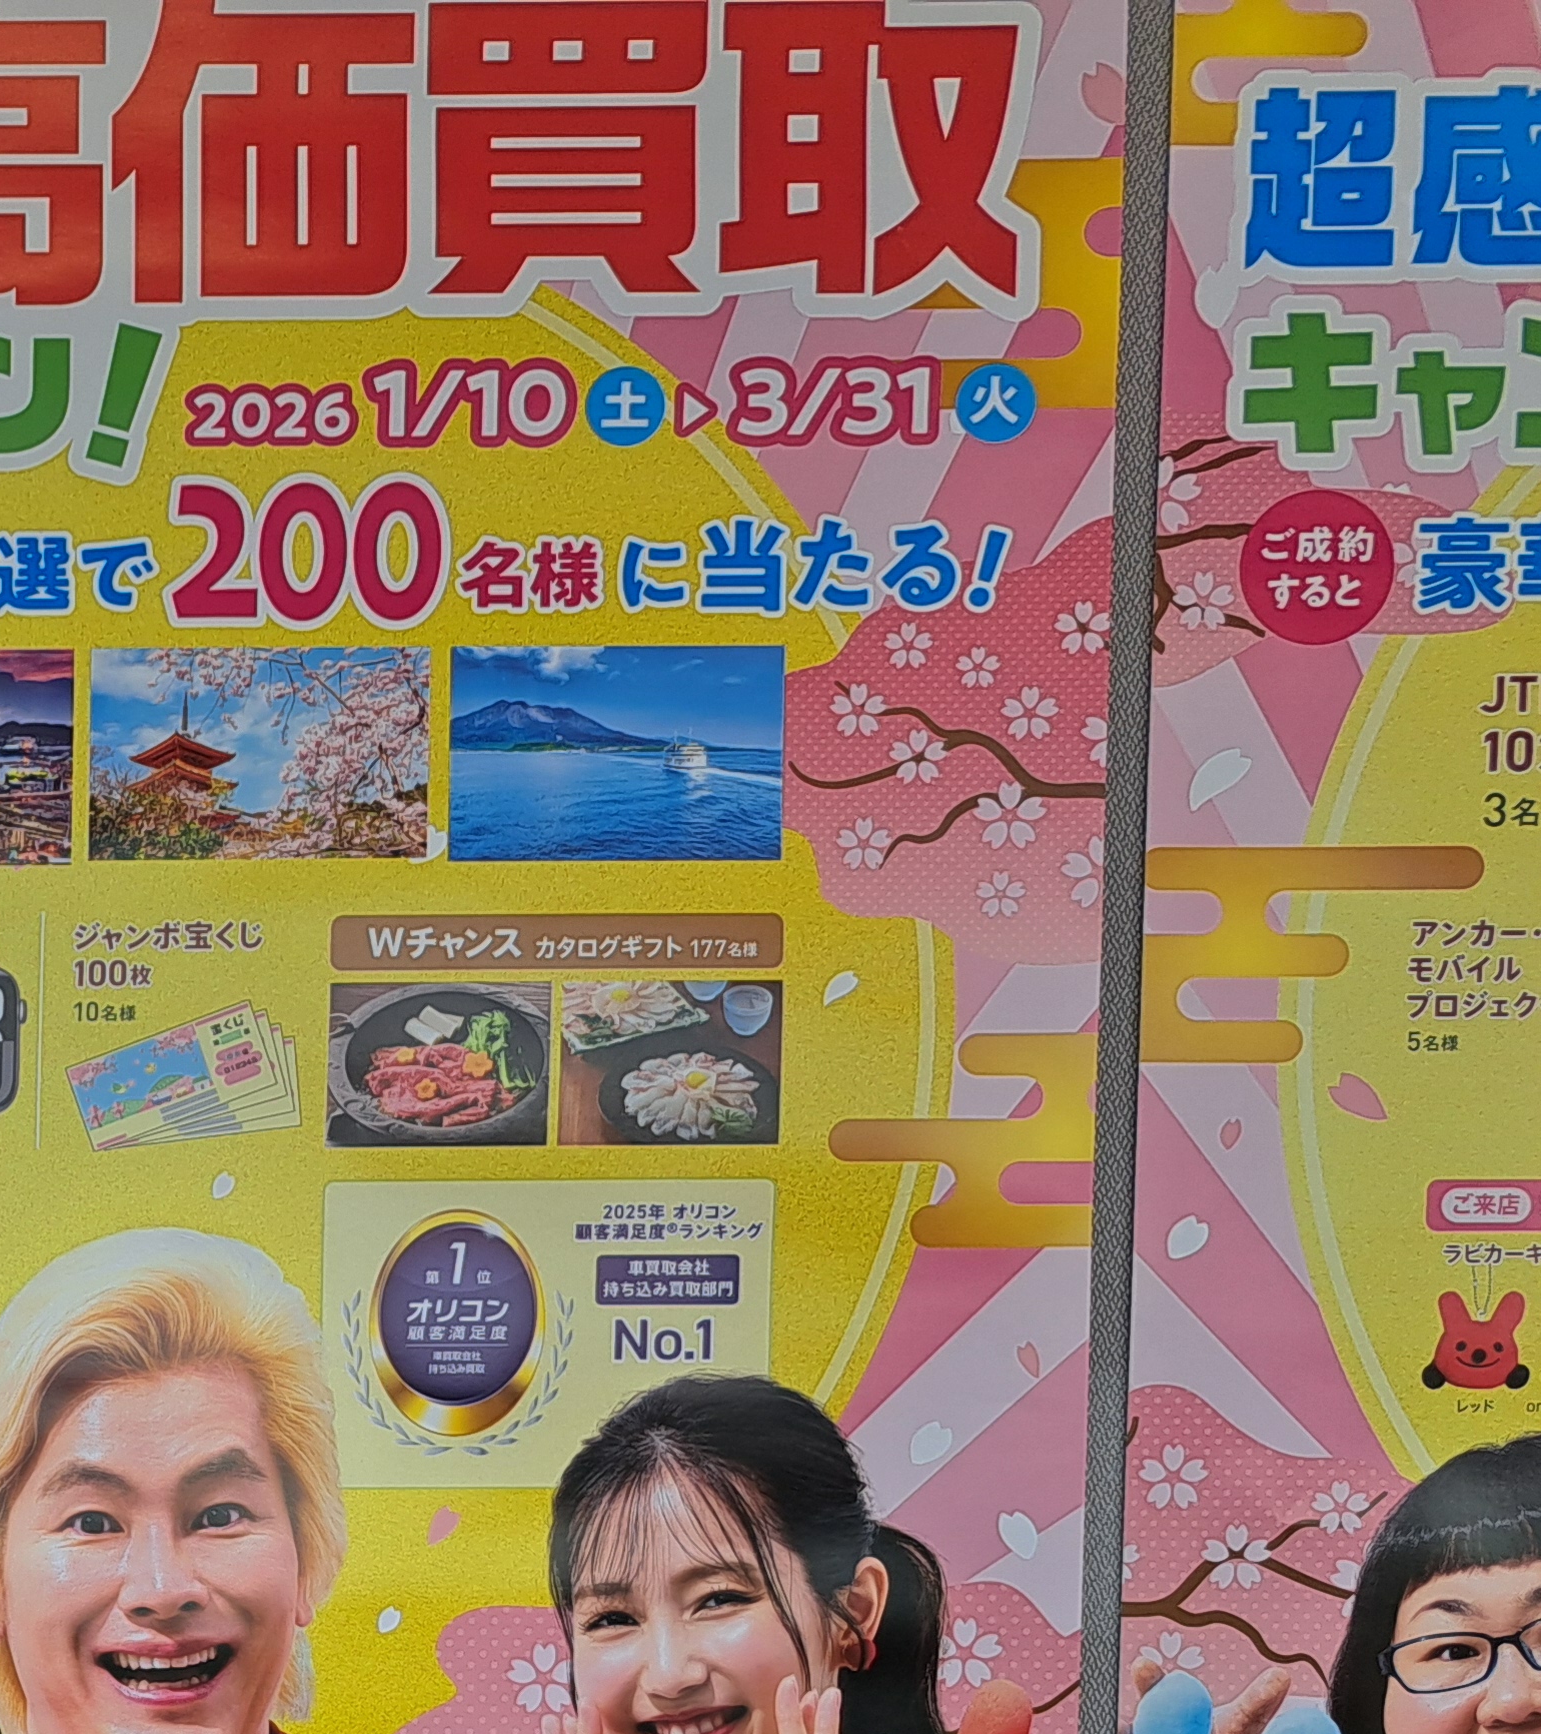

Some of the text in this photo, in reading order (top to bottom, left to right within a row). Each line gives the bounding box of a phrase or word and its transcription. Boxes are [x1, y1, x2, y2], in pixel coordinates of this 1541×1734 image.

[1243, 312, 1541, 455] キャ
[193, 367, 1022, 438] 2026 1/10 土 3/31 火
[1261, 529, 1374, 563] ご成約
[72, 921, 264, 952] ジャンボ宝くじ
[369, 928, 759, 960] Wチャンス カタログギフト 177名様
[73, 960, 151, 987] 100枚
[73, 1002, 136, 1024] 10名様
[603, 1204, 737, 1221] 2025年 オリコン
[629, 1260, 710, 1277] 車買取会社
[603, 1281, 734, 1298] 持ち込み買取部門
[407, 1299, 509, 1321] オリコン
[407, 1325, 508, 1341] 顧客満足度
[613, 1318, 713, 1360] No.1
[432, 1351, 482, 1361] 車買取会社
